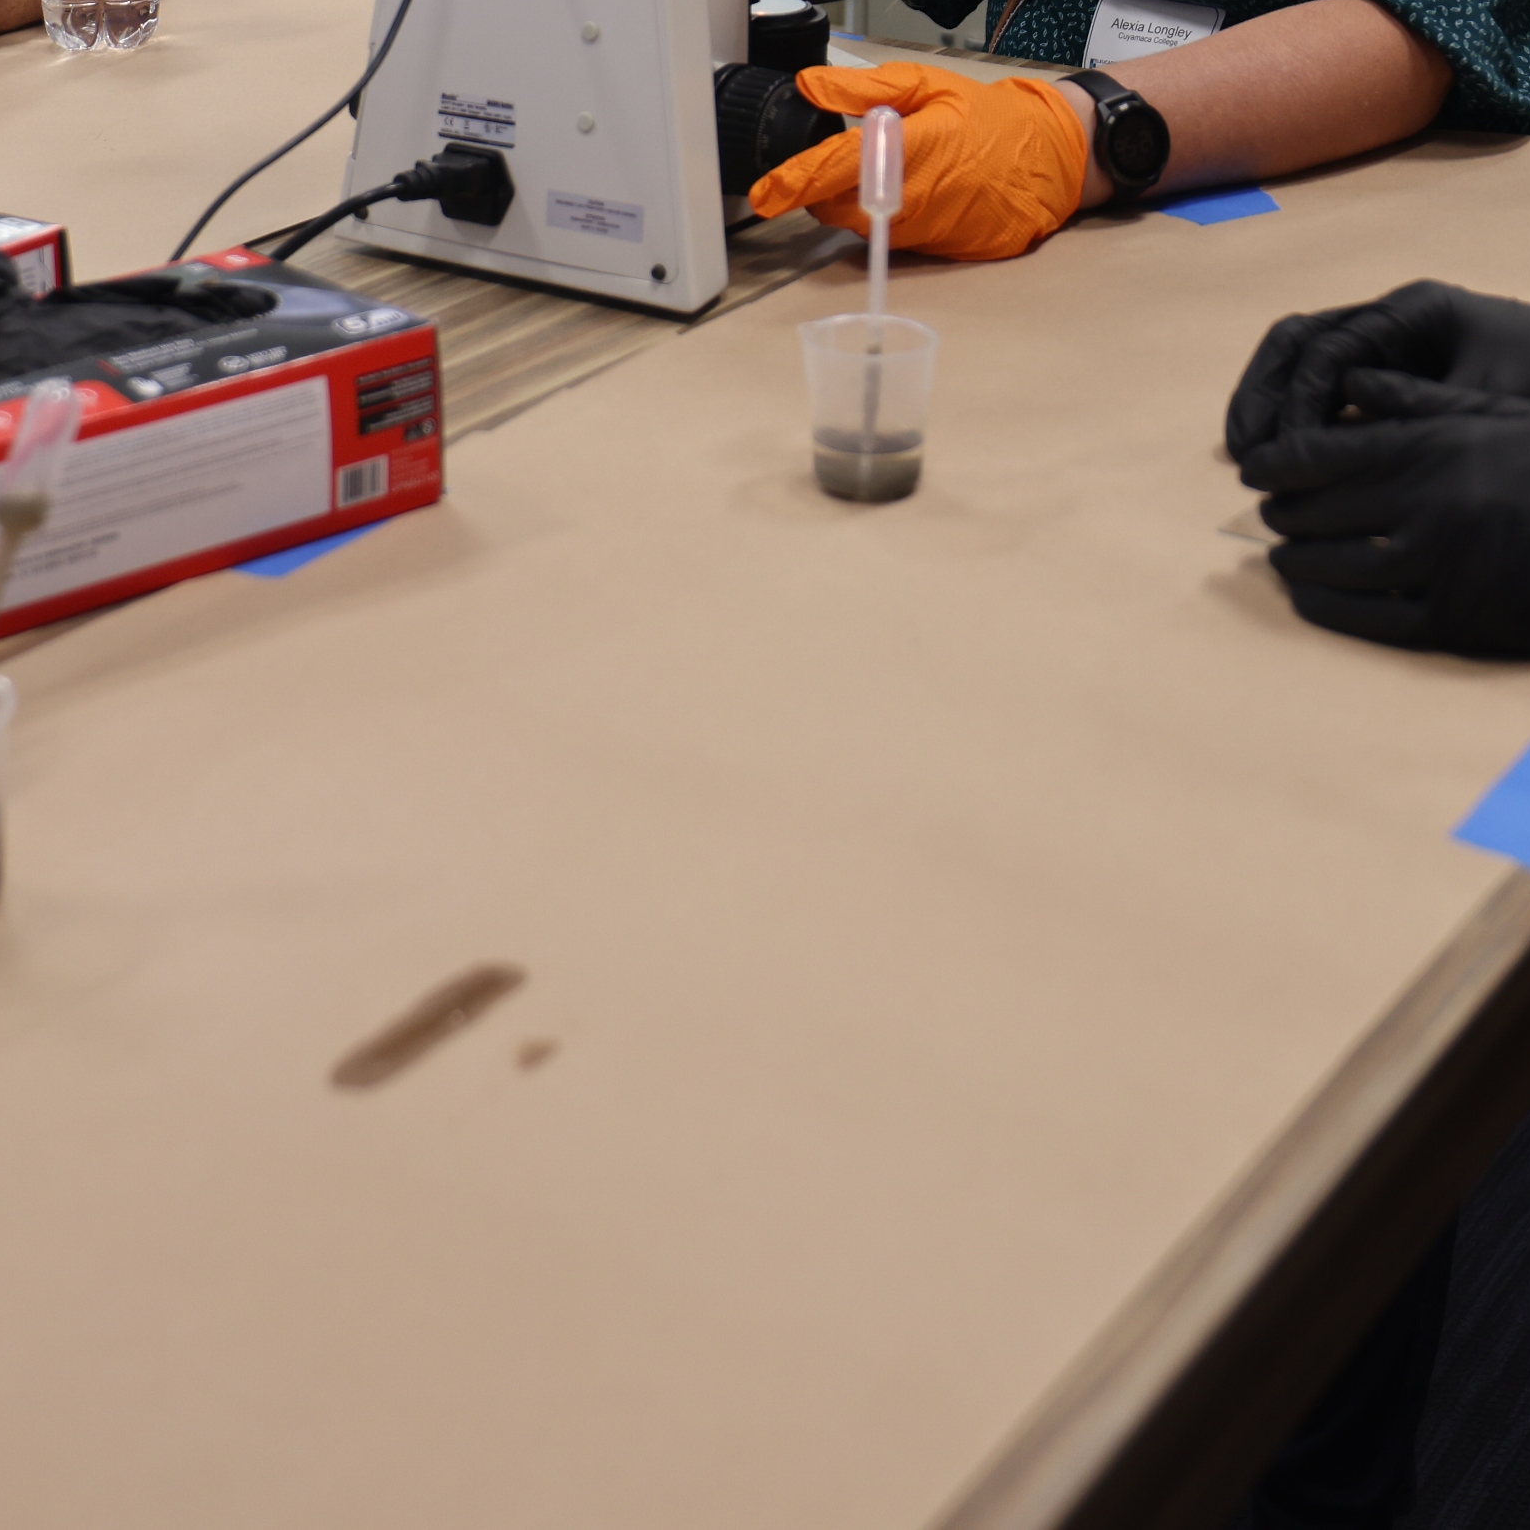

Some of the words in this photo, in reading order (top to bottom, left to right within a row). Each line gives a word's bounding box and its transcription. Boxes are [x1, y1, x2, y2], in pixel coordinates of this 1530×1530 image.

[1111, 18, 1145, 32] Alexia
[1148, 23, 1192, 41] Longley
[1118, 32, 1153, 43] Cuyamaca
[1154, 36, 1179, 47] College
